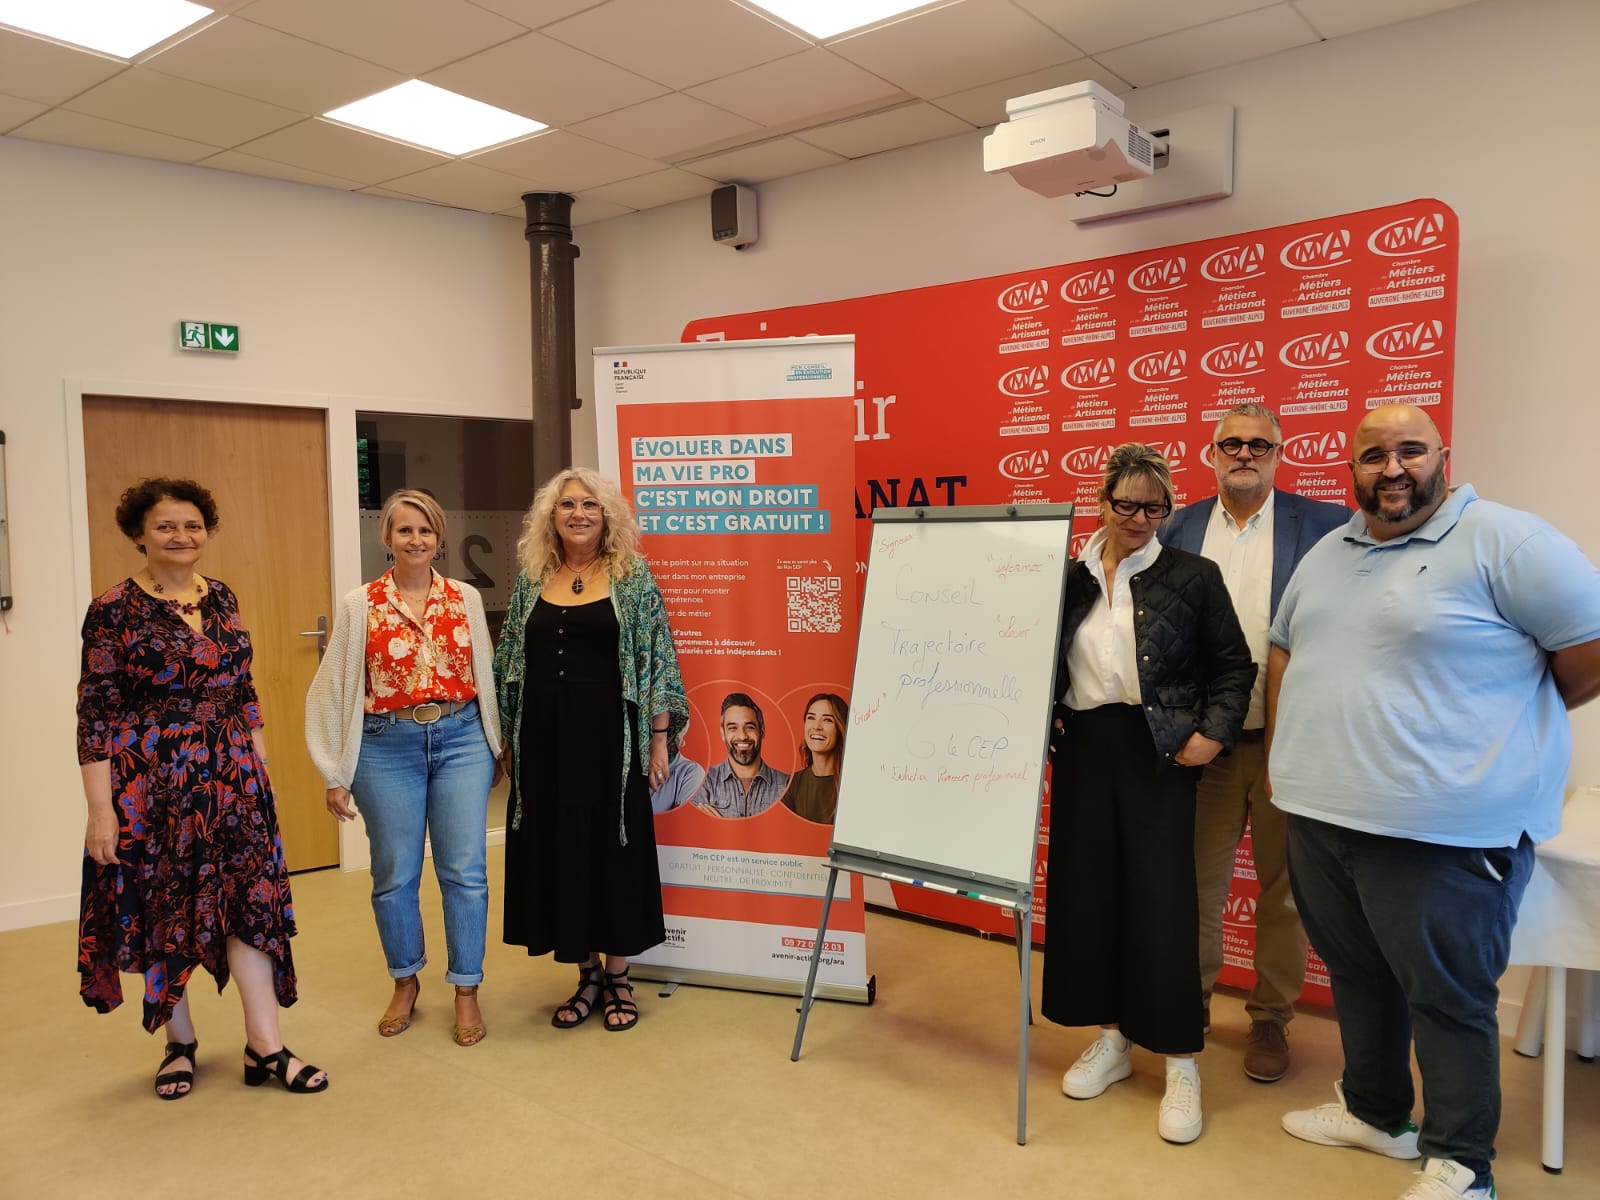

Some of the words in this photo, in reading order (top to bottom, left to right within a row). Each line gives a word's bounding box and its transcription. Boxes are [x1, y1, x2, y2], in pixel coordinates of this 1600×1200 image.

[1389, 265, 1435, 279] Métiers
[1299, 278, 1341, 291] Métiers
[1386, 274, 1446, 289] Artisanat
[1218, 290, 1256, 302] Métiers
[1298, 287, 1352, 302] Artisanat
[1144, 302, 1179, 312] Métiers
[1216, 299, 1265, 313] Artisanat
[1076, 311, 1108, 322] Métiers
[1143, 310, 1188, 322] Artisanat
[1012, 321, 1042, 330] Métiers
[1075, 320, 1116, 331] Artisanat
[1011, 329, 1049, 339] Artisanat
[1386, 370, 1431, 382] Métiers
[1298, 379, 1339, 390] Métiers
[1384, 380, 1442, 392] Artisanat
[1218, 386, 1256, 396] Métiers
[1296, 388, 1349, 400] Artisanat
[1144, 393, 1179, 402] Métiers
[1217, 395, 1264, 406] Artisanat
[1076, 399, 1108, 408] Métiers
[1143, 401, 1188, 412] Artisanat
[1012, 405, 1042, 414] Métiers
[1075, 408, 1116, 417] Artisanat
[1012, 414, 1050, 423] Artisanat
[635, 438, 723, 456] ÉVOLUER
[730, 438, 786, 454] DANS
[636, 466, 665, 481] MA
[672, 466, 703, 481] VIE
[710, 465, 749, 480] PRO
[1296, 478, 1337, 487] Métiers
[1013, 489, 1042, 497] Métiers
[1296, 488, 1347, 496] Artisanat
[637, 491, 688, 507] C'EST
[696, 491, 744, 506] MON
[749, 489, 812, 505] DROIT
[639, 516, 660, 531] ET
[666, 516, 718, 530] C'EST
[725, 515, 812, 530] GRATUIT
[709, 573, 745, 581] entreprise
[689, 609, 711, 617] métier
[727, 648, 776, 657] indépendants
[968, 736, 1008, 759] CEP
[693, 853, 708, 861] Mon
[752, 858, 778, 866] service
[1222, 935, 1248, 945] étiers
